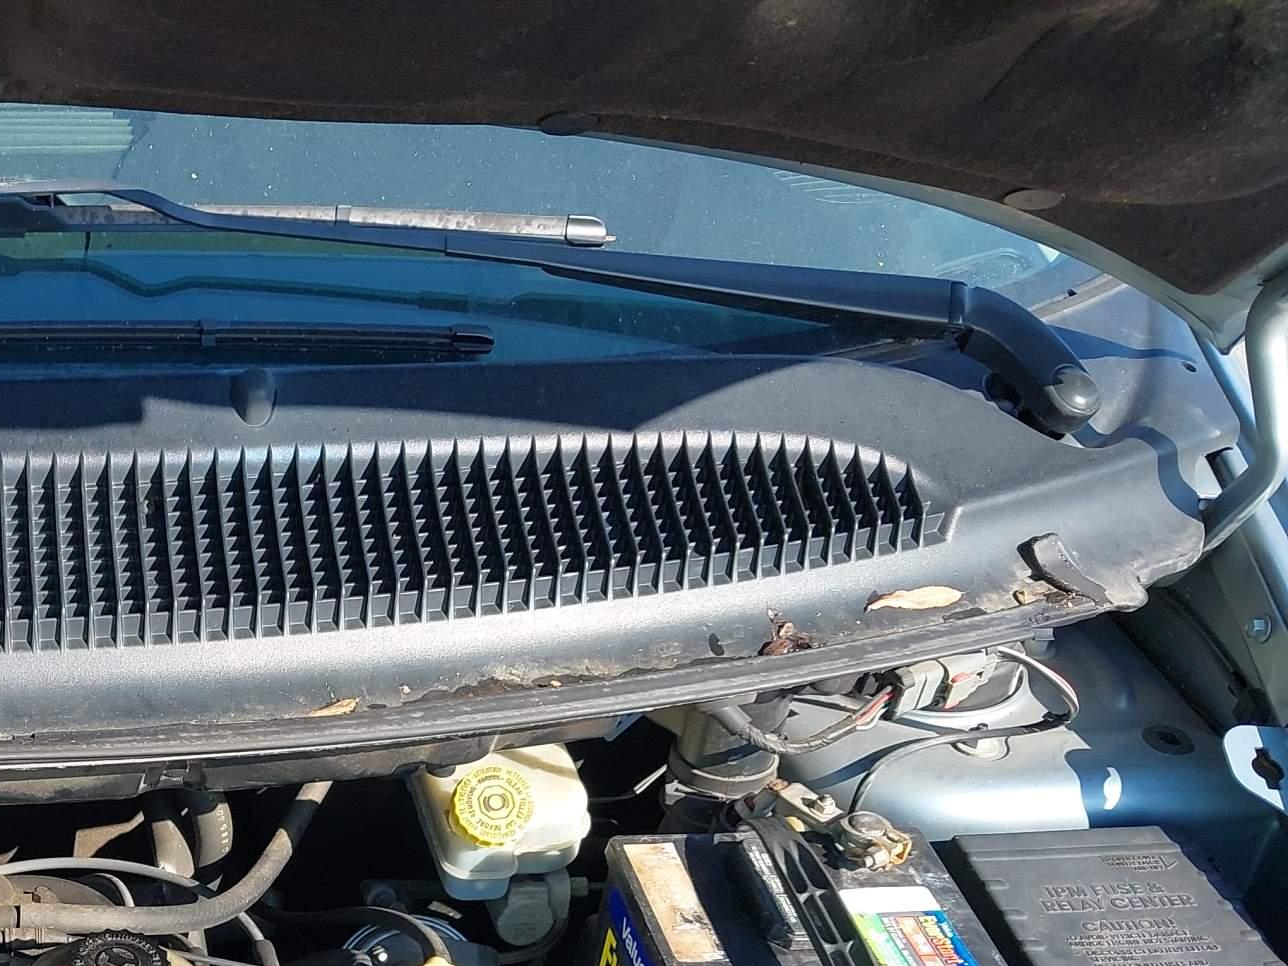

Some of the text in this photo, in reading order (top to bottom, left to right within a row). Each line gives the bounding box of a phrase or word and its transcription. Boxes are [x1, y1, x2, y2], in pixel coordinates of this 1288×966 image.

[1043, 881, 1167, 899] IPM FUSE &
[1042, 892, 1198, 913] RELAY CENTER
